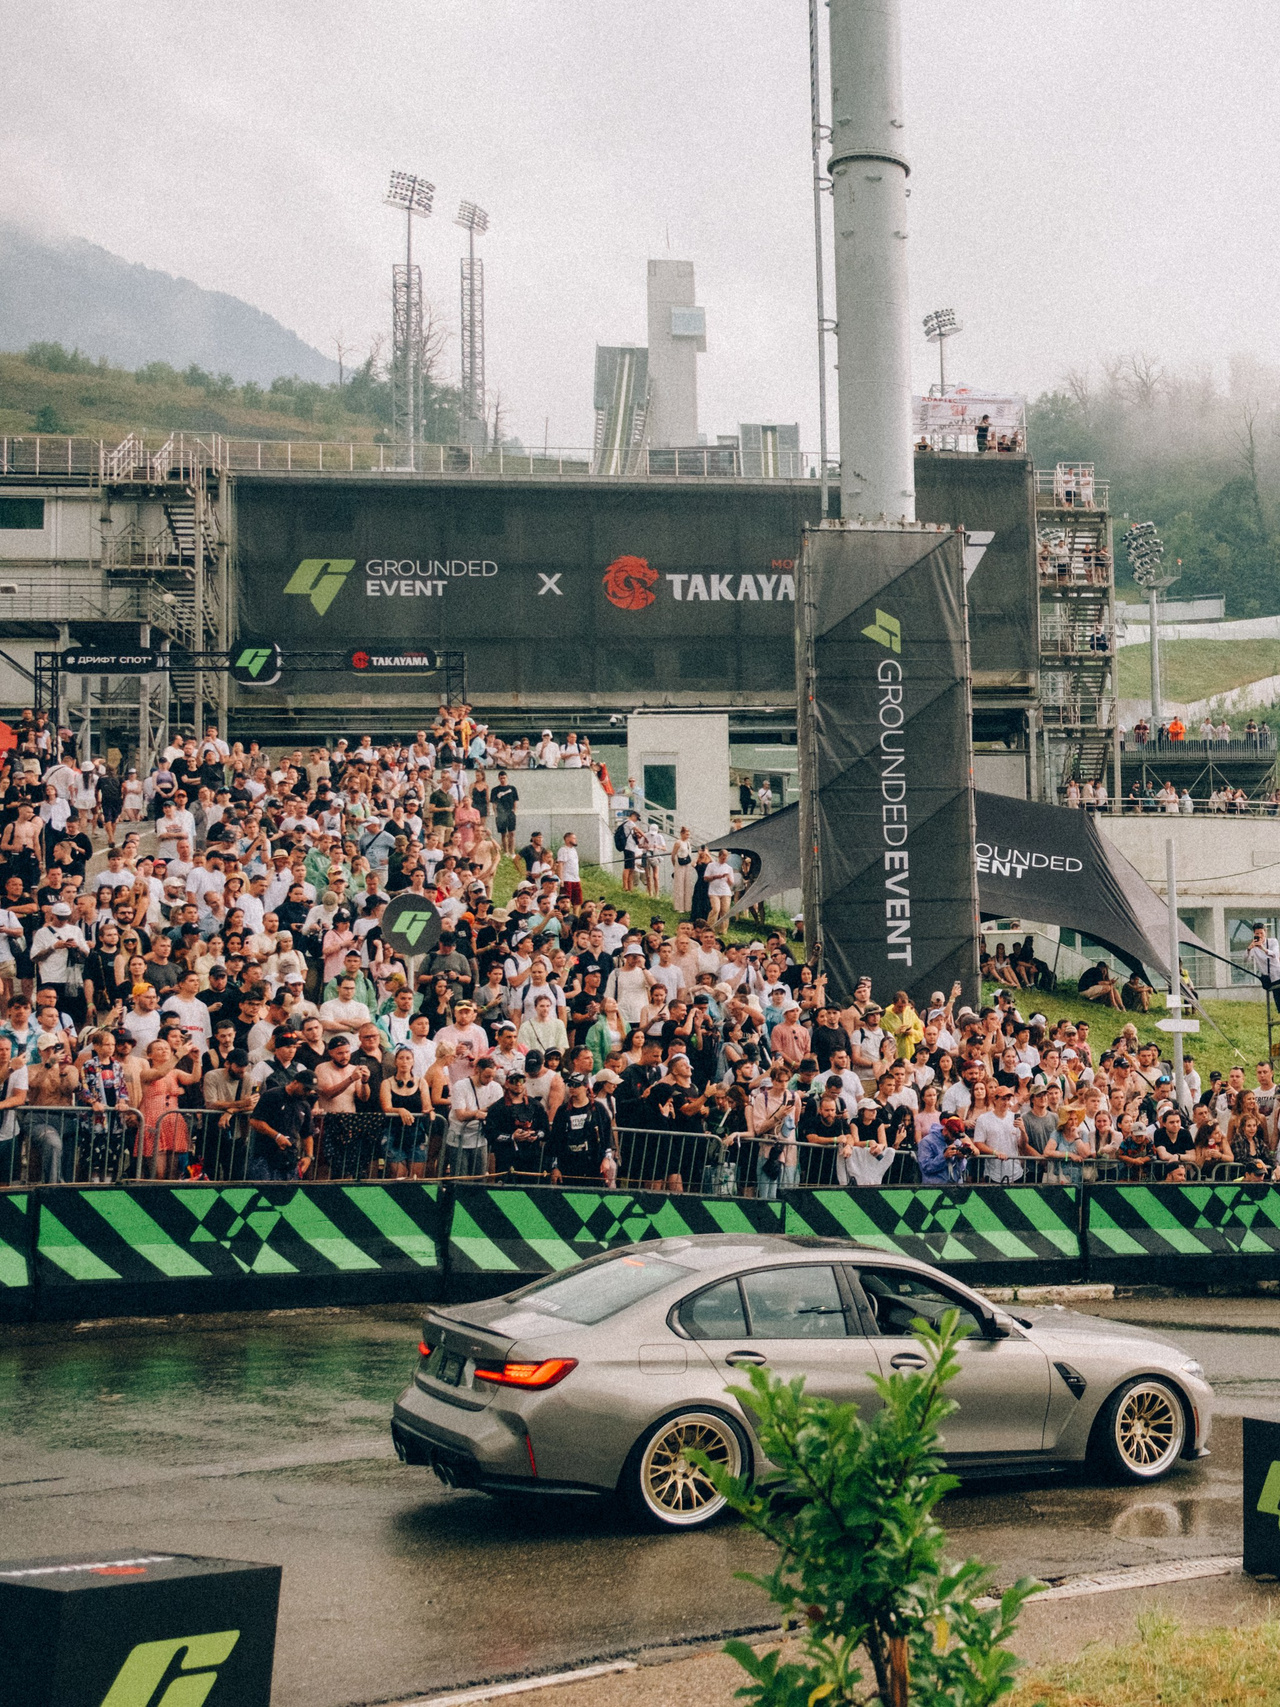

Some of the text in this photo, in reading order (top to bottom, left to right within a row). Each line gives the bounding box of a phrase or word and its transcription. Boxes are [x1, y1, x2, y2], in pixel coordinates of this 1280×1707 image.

[365, 559, 499, 577] GROUNDED
[366, 580, 448, 597] EVENT
[537, 572, 564, 596] X
[665, 573, 796, 601] TAKAYA
[77, 656, 117, 664] ДРИФТ
[370, 656, 429, 666] TAKAYAMA
